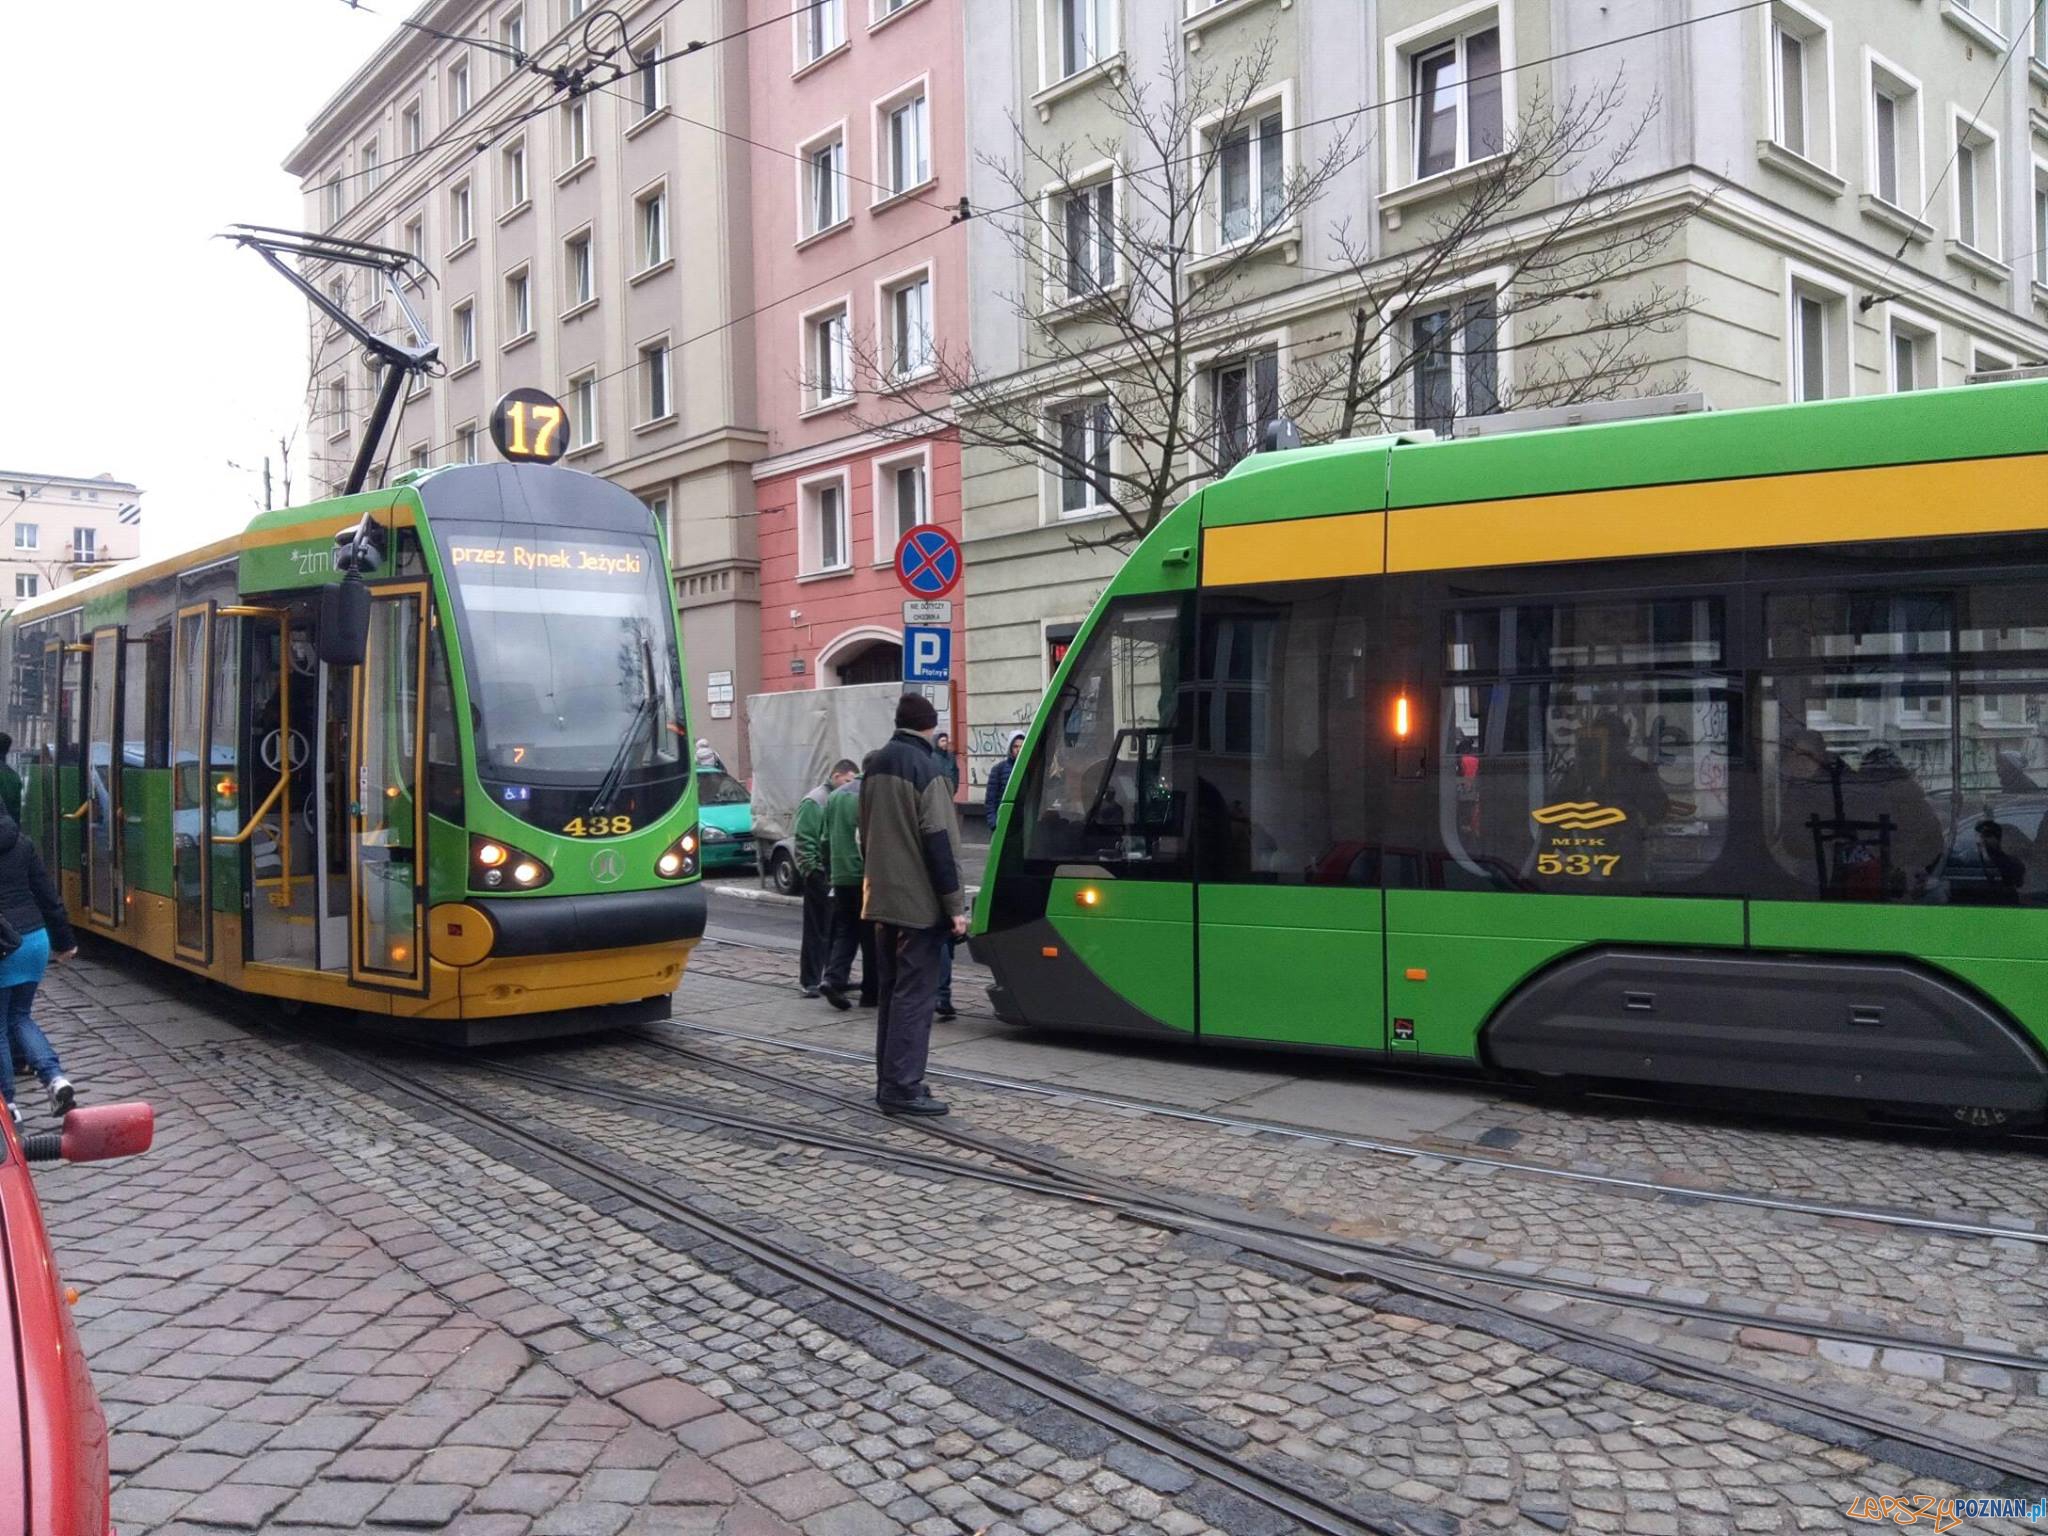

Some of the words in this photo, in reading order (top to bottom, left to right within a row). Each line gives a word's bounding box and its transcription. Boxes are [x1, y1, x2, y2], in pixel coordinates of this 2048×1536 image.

[507, 401, 560, 456] 17
[451, 546, 506, 566] przez
[513, 546, 571, 570] Rynek
[577, 551, 641, 575] Jeżycki
[914, 632, 941, 676] P
[513, 747, 525, 763] 7
[562, 815, 632, 836] 438
[1551, 837, 1606, 846] MPK
[1536, 854, 1622, 876] 537
